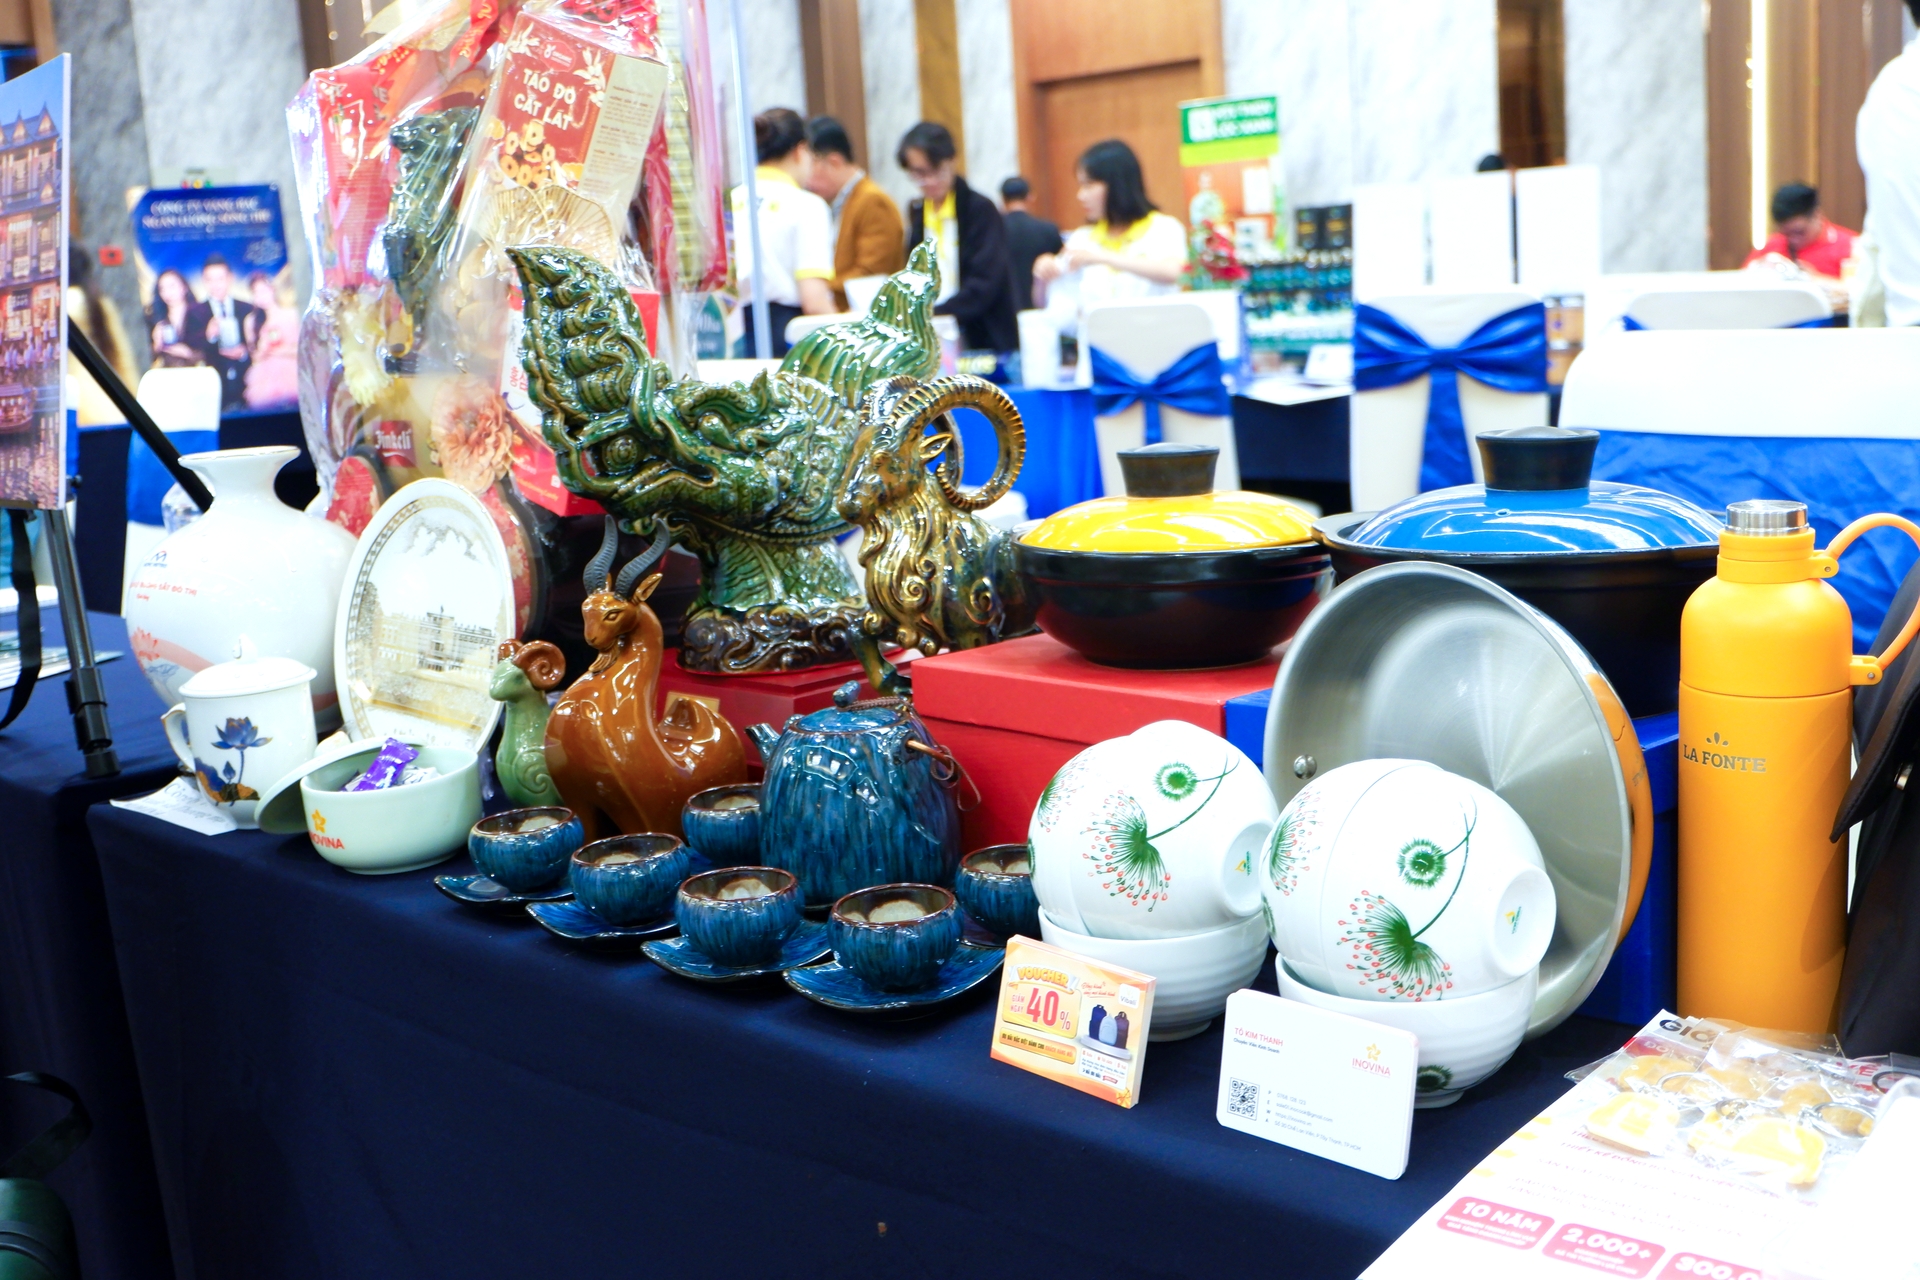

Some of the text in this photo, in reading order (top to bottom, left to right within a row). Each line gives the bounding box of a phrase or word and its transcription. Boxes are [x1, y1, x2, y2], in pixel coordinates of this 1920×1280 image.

[523, 68, 550, 93] TÁO
[1683, 744, 1767, 773] LA FONTE
[1017, 966, 1069, 987] VOUCHER
[1245, 1030, 1258, 1040] KIM
[1352, 1058, 1391, 1076] INOVINA
[1462, 1201, 1542, 1232] 10 NĂM
[1561, 1228, 1652, 1260] 2.000+
